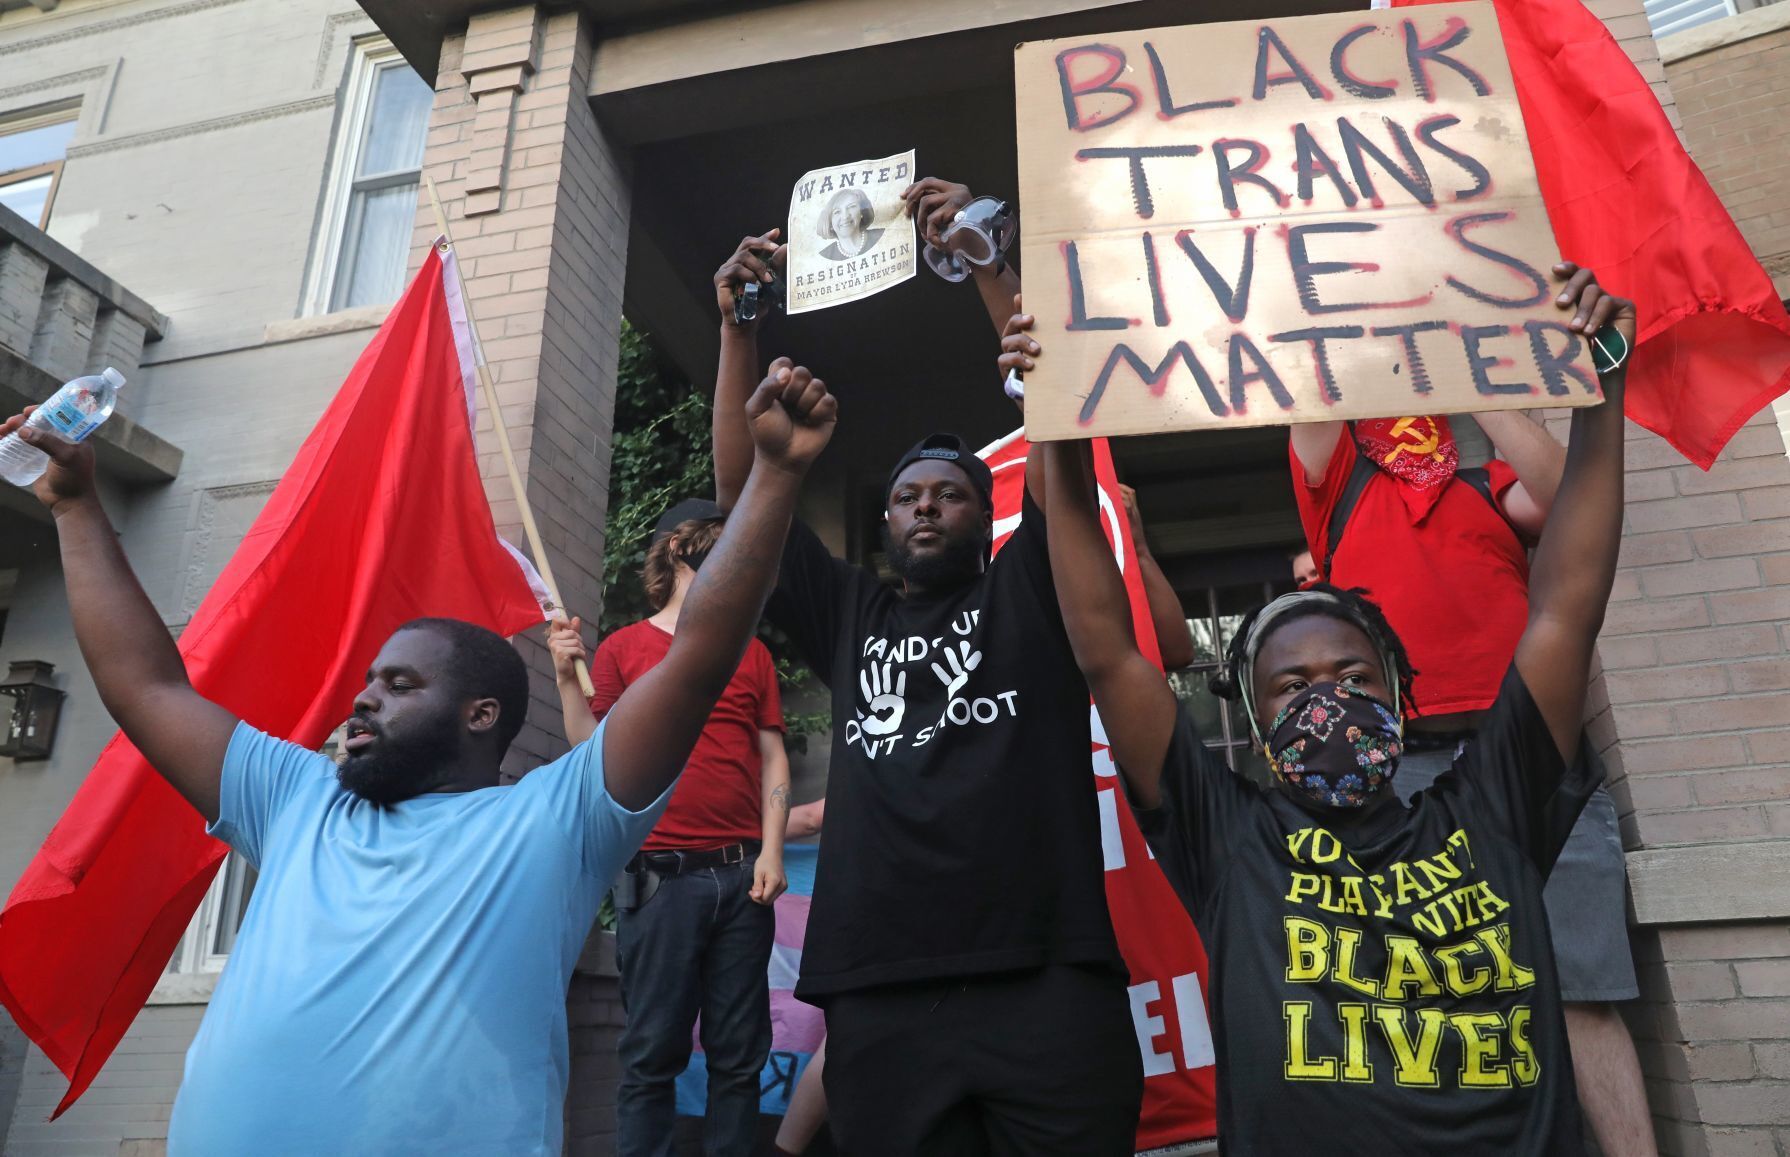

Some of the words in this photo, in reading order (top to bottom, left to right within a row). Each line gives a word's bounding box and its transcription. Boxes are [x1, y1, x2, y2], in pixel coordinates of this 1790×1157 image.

[1055, 17, 1492, 131] BLACK
[799, 161, 908, 202] WANTED
[1075, 115, 1494, 218] TRANS
[796, 243, 910, 287] RESIGNATION
[797, 285, 833, 300] MAYOR
[835, 277, 861, 292] LYDA
[1060, 209, 1550, 330] LIVES
[1076, 320, 1602, 426] MATTER
[863, 635, 943, 663] AND
[846, 719, 903, 760] DN'T
[1285, 872, 1394, 919] PLAY
[1283, 916, 1536, 1002] BLACK
[1283, 1001, 1541, 1088] LIVES
